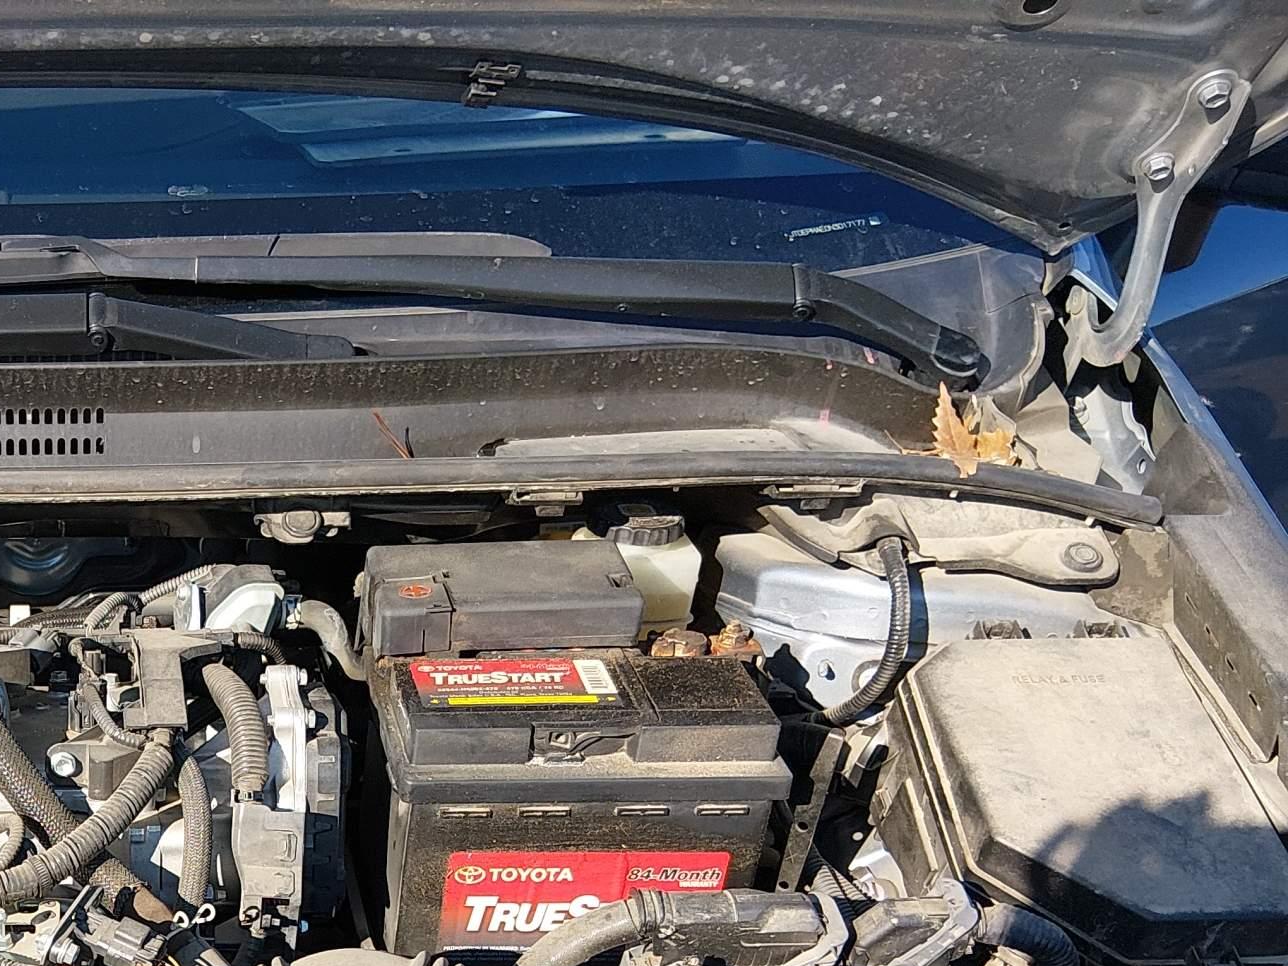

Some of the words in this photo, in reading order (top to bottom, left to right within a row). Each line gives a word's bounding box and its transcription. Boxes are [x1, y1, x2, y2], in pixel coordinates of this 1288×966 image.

[1012, 674, 1053, 684] RELAY
[1071, 674, 1105, 684] FUSE
[489, 867, 573, 882] TOYOTA
[627, 867, 722, 881] 84-Month
[464, 895, 605, 932] TRUES
